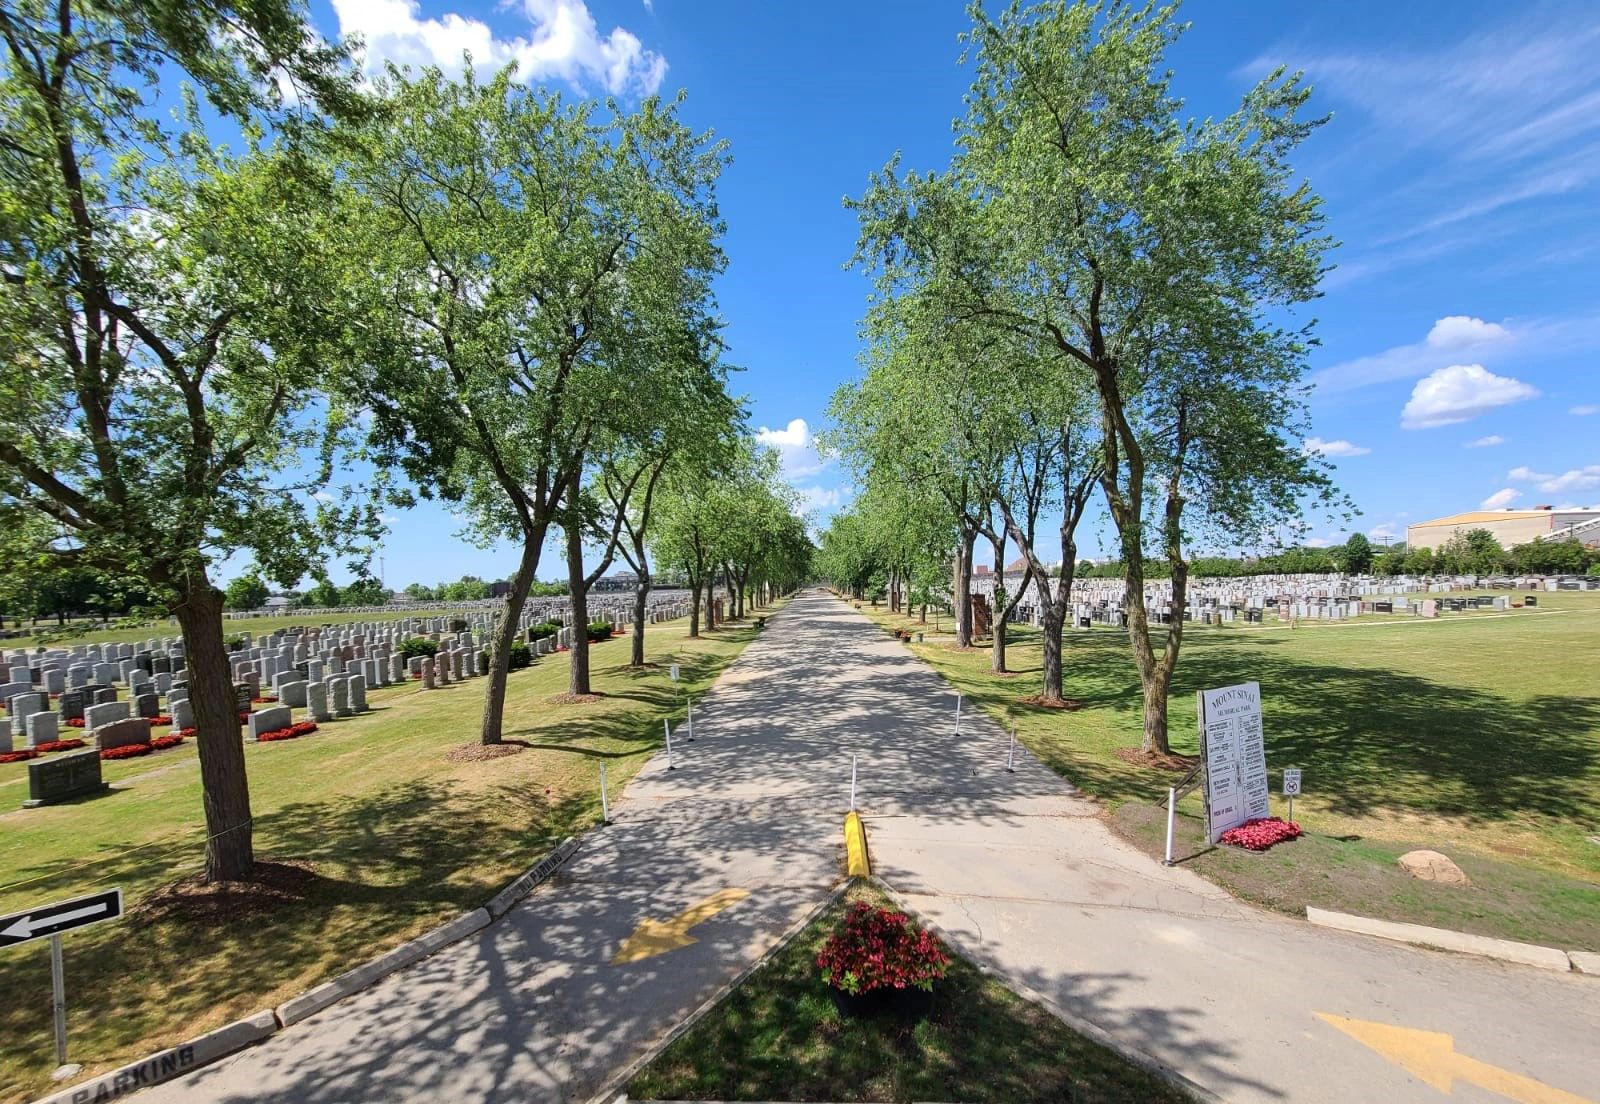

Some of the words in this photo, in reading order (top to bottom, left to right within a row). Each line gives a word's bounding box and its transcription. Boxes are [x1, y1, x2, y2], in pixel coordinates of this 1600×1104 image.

[1211, 689, 1236, 709] MOUNT
[1237, 689, 1256, 703] SINAI
[1217, 707, 1240, 716] MEMORIAL
[1240, 704, 1252, 712] PARK
[517, 879, 532, 894] NO
[530, 852, 563, 883] PARKING
[71, 1045, 195, 1104] PARKING
